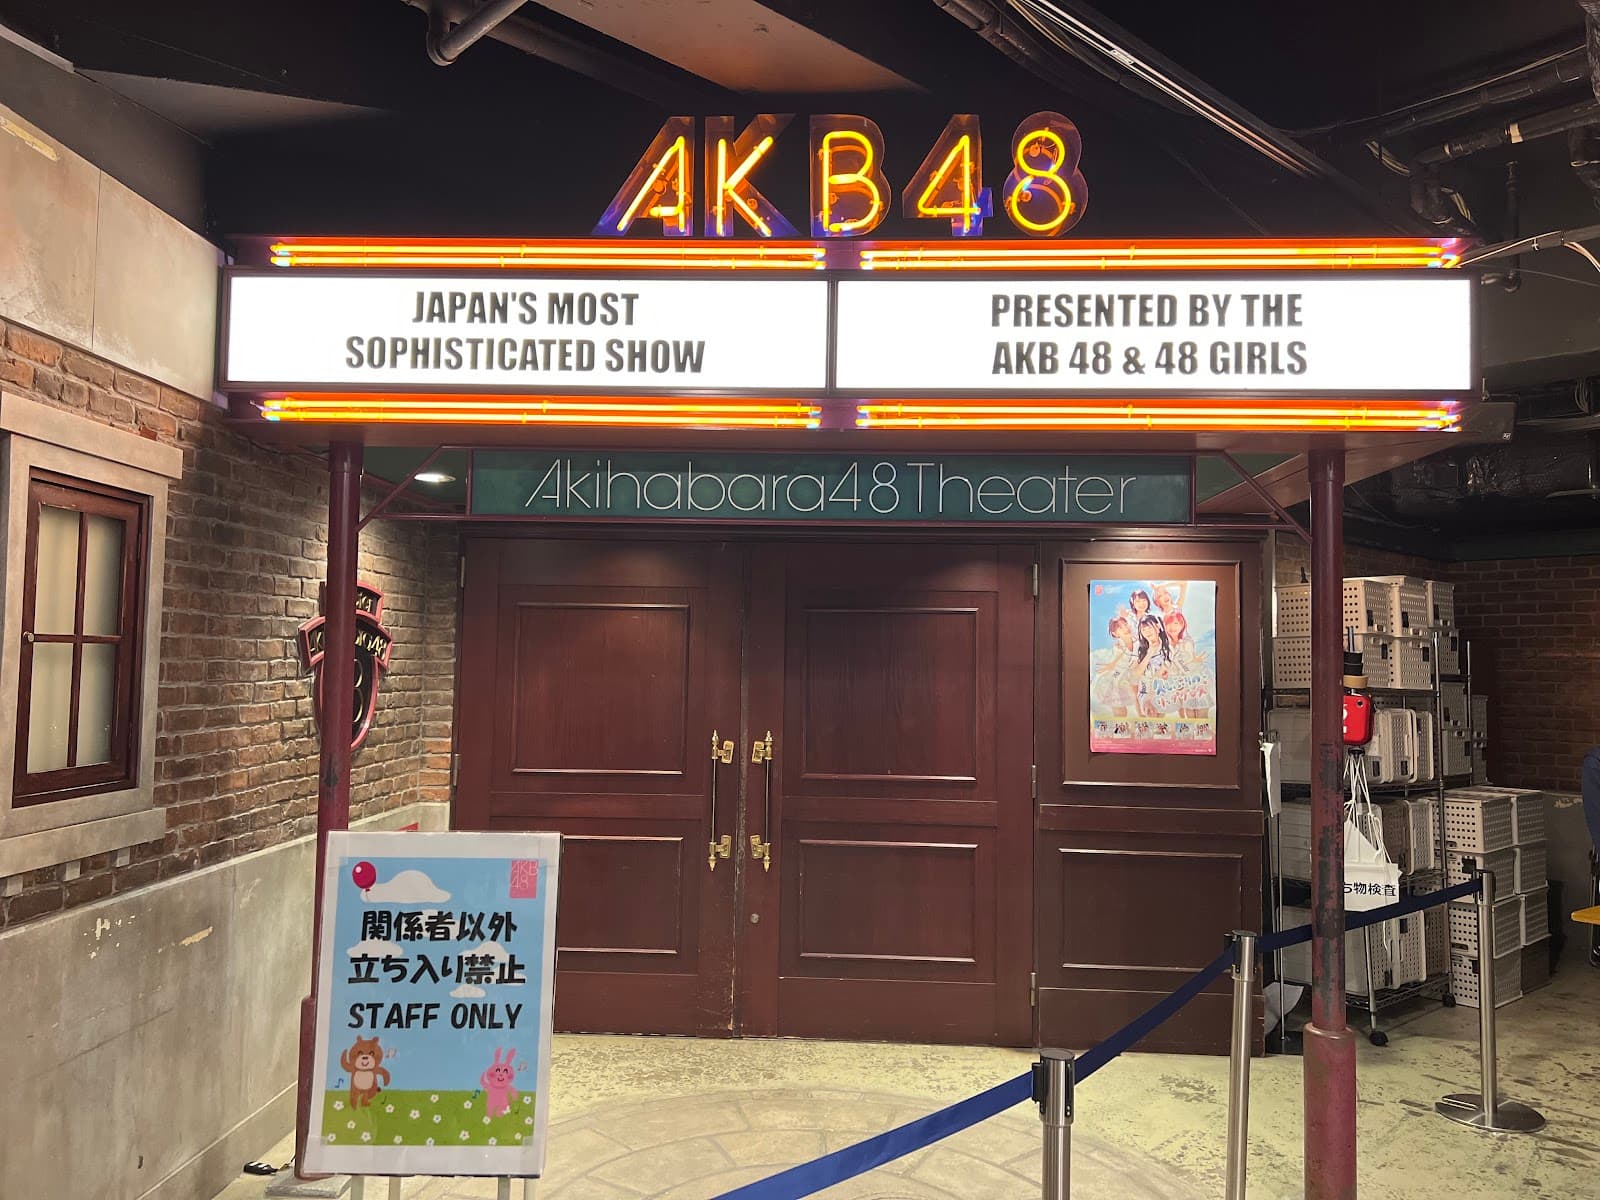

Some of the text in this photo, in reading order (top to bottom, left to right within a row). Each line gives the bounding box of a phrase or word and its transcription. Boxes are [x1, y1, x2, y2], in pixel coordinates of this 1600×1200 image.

[413, 292, 638, 325] JAPAN'S MOST
[992, 294, 1302, 327] PRESENTED BY THE
[347, 336, 705, 373] SOPHISTICATED SHOW
[992, 342, 1306, 374] AKB 48 & 48 GIRLS
[361, 911, 517, 942] 関係者以外
[348, 953, 526, 985] 立ち入り禁止
[348, 1003, 523, 1029] STAFF ONLY
